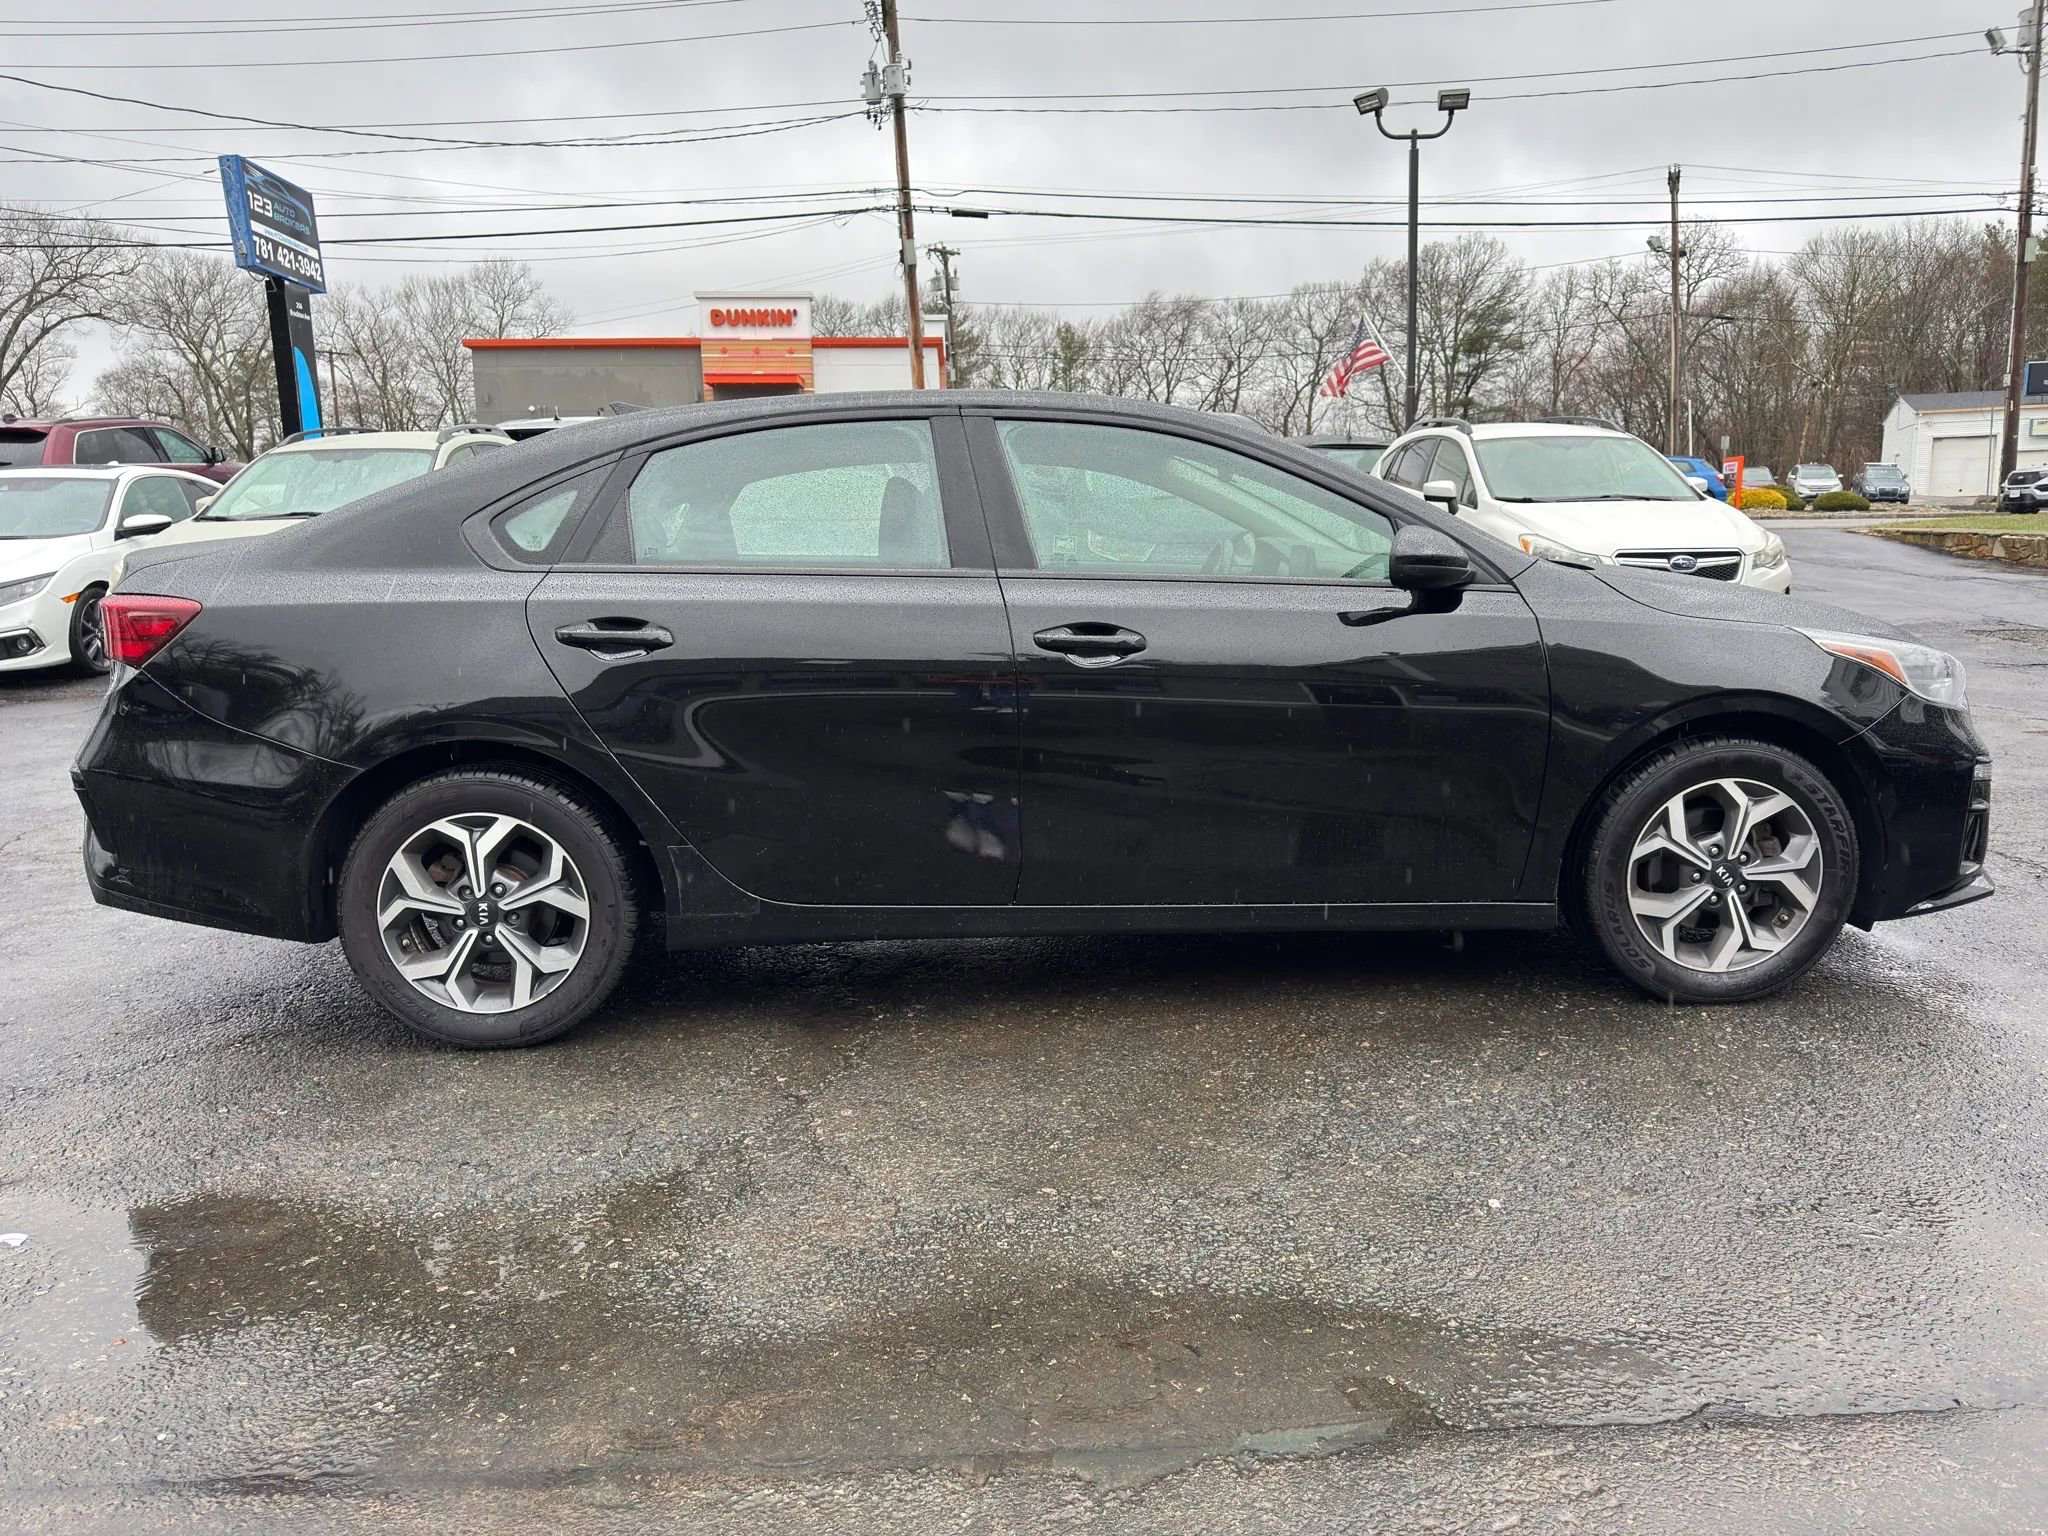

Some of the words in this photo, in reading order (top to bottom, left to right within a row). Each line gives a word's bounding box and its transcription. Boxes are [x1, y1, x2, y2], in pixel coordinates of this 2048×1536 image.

[247, 190, 273, 218] 123
[273, 202, 296, 218] AUTO
[273, 212, 311, 236] BROKERS
[252, 234, 274, 262] 781
[276, 245, 323, 282] 421-3942
[710, 308, 798, 327] DUNKIN'
[1715, 865, 1734, 887] KIA
[478, 902, 489, 925] KIA
